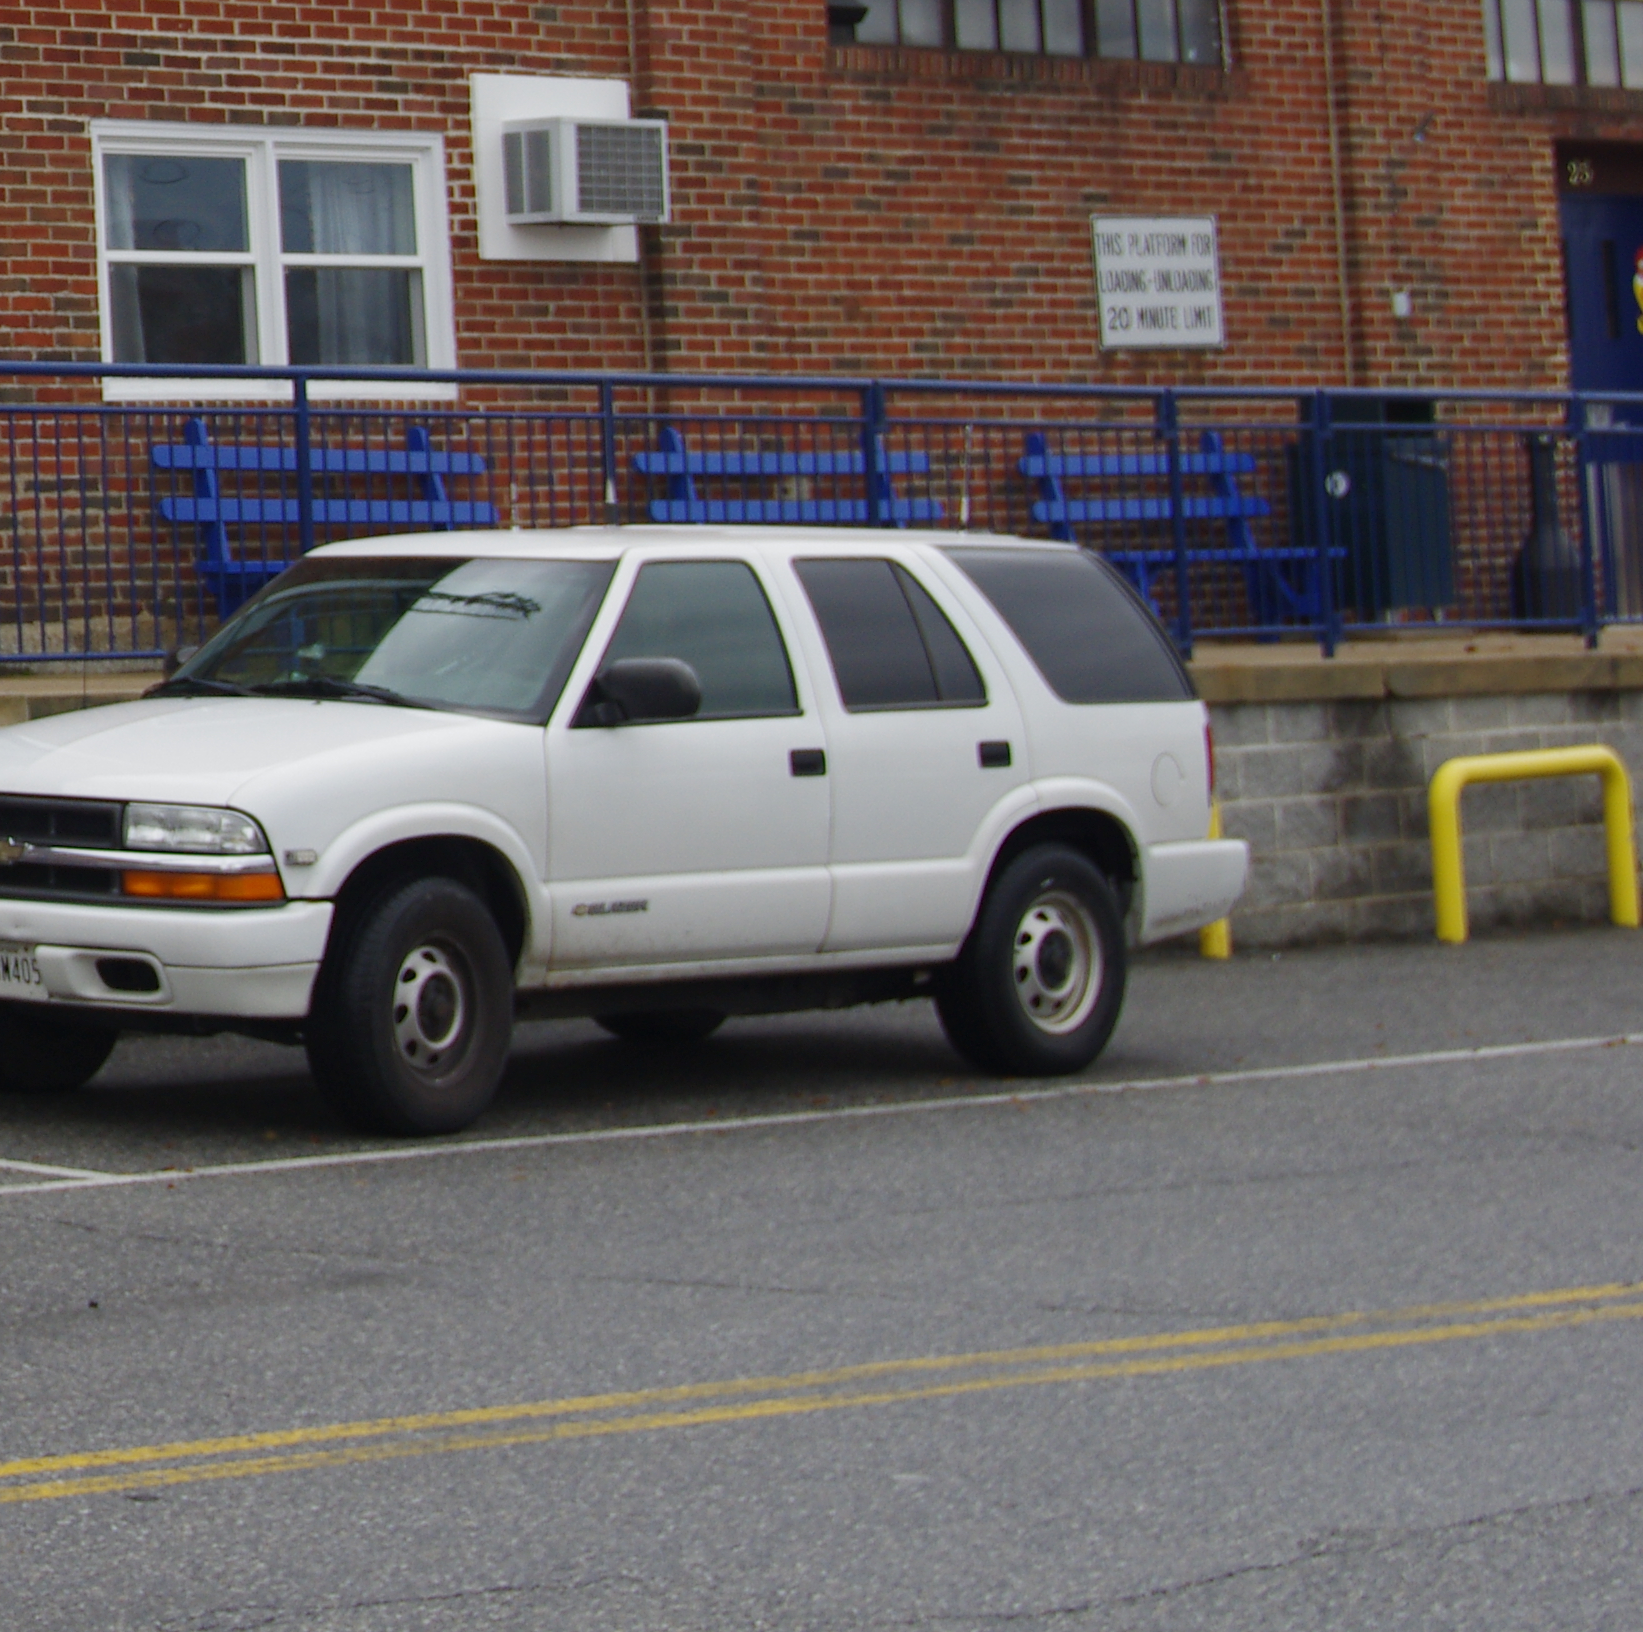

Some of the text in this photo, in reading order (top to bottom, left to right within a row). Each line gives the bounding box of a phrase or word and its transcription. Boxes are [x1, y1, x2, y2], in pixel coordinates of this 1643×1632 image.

[1095, 233, 1211, 256] THIS PLATFORM FOR
[1106, 306, 1211, 330] 20 MINUTE LIMIT
